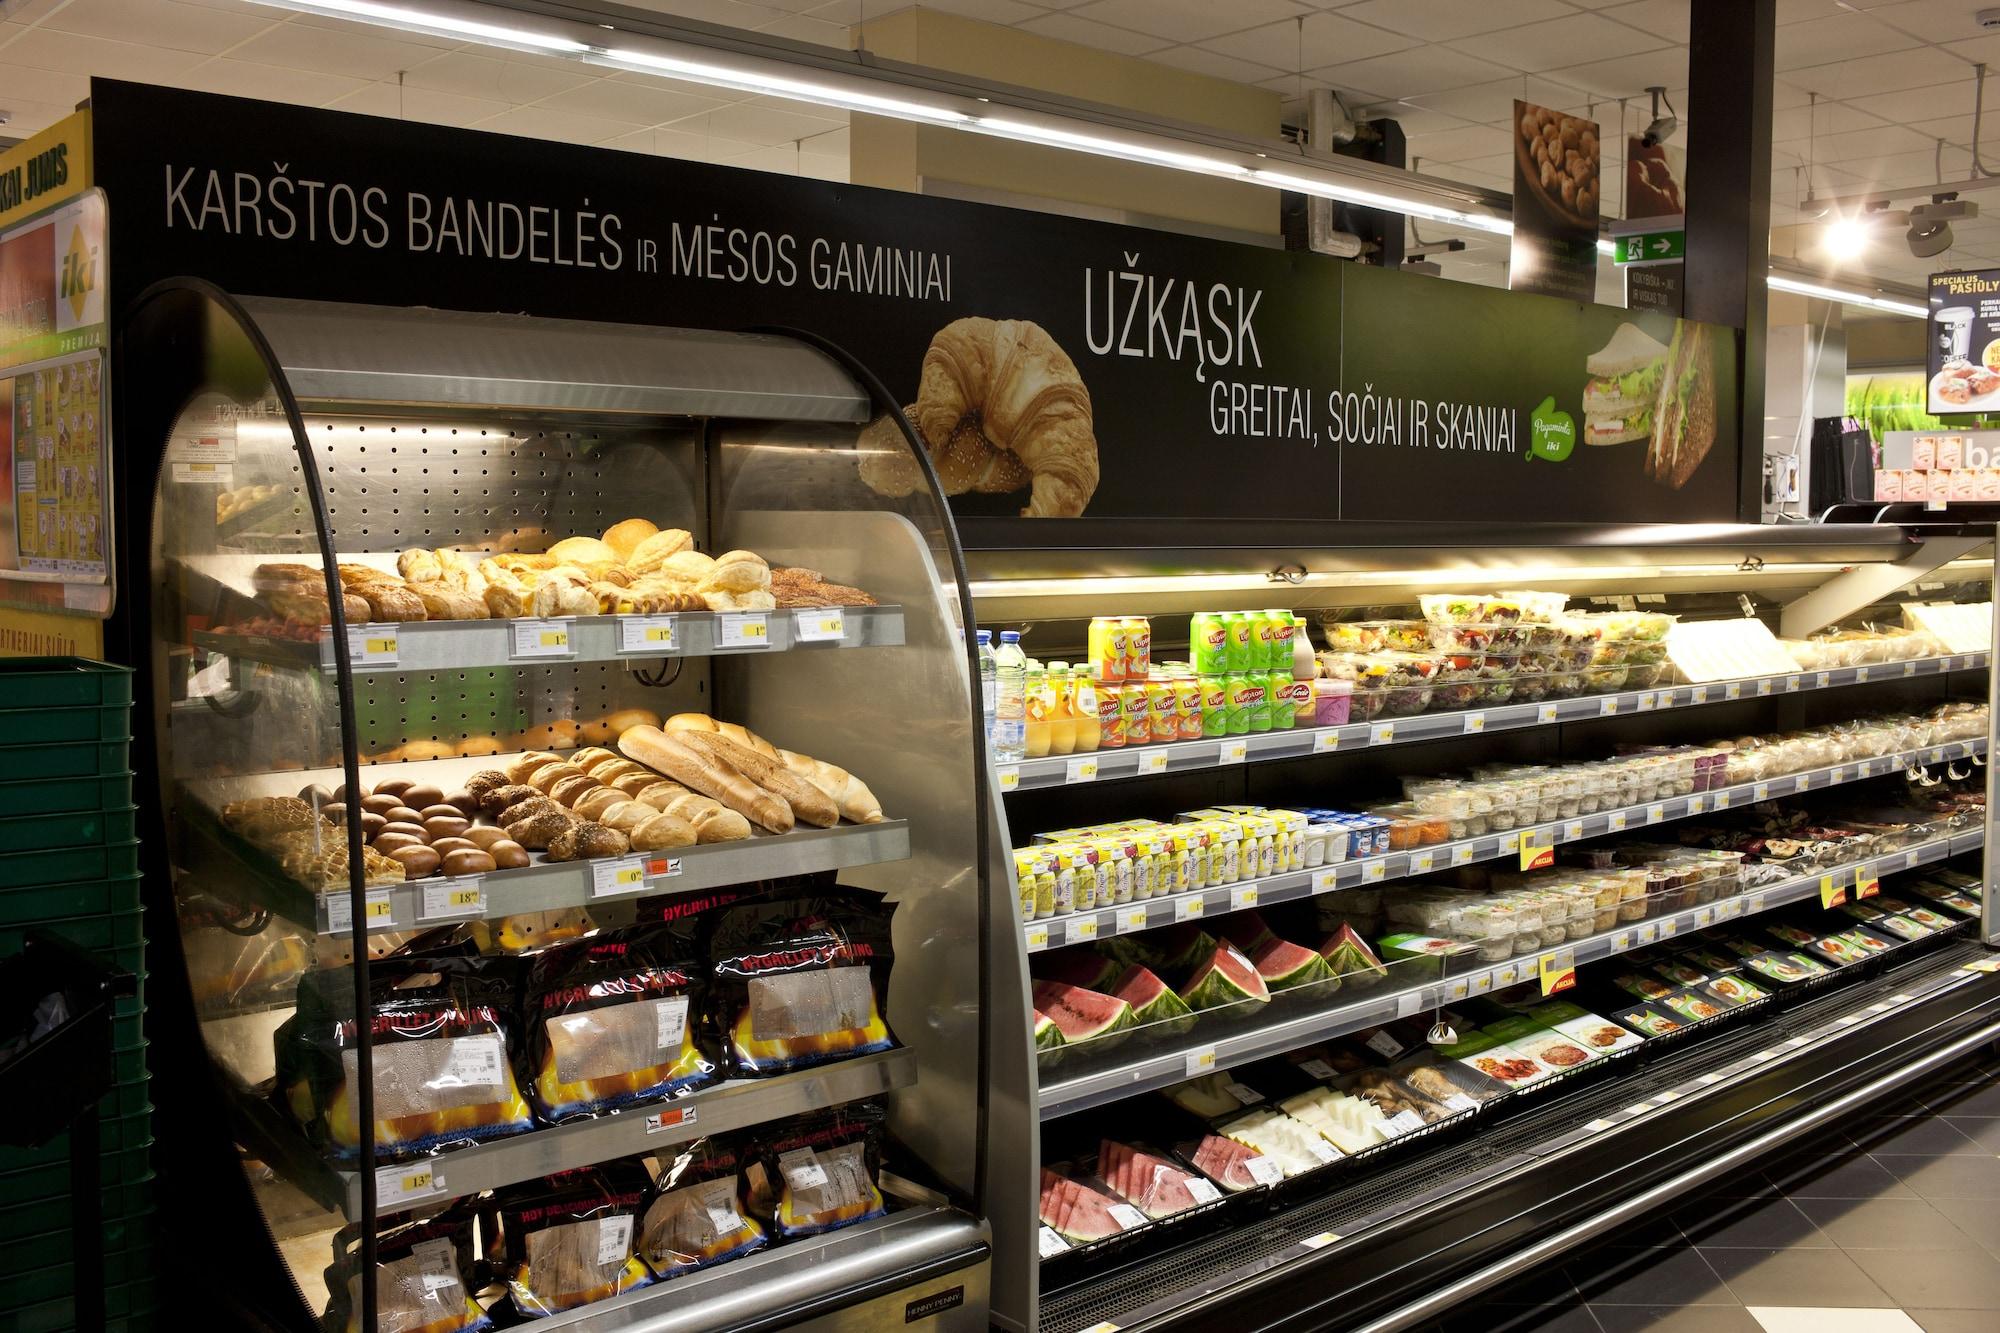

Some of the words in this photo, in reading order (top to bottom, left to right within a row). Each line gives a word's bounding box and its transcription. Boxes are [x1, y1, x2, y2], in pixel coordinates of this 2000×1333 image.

[24, 143, 68, 200] JUMS
[166, 161, 389, 248] KARŠTOS
[408, 192, 624, 271] BANDELĖS
[637, 238, 657, 273] IR
[672, 213, 797, 287] MĖSOS
[811, 238, 952, 302] GAMINIAI
[60, 246, 98, 299] iki
[1933, 275, 1979, 286] SPECIALUS
[1949, 279, 2000, 295] PASIŪLY
[1085, 250, 1263, 383] UŽKĄSK
[1209, 380, 1318, 448] GREITAI,
[1327, 382, 1403, 447] SOČIAI
[1409, 399, 1429, 448] IR
[1435, 401, 1516, 453] SKANIAI
[1535, 418, 1571, 439] Pagaminta
[1546, 441, 1560, 451] iki
[1100, 702, 1117, 713] pton
[521, 1209, 543, 1222] HOT
